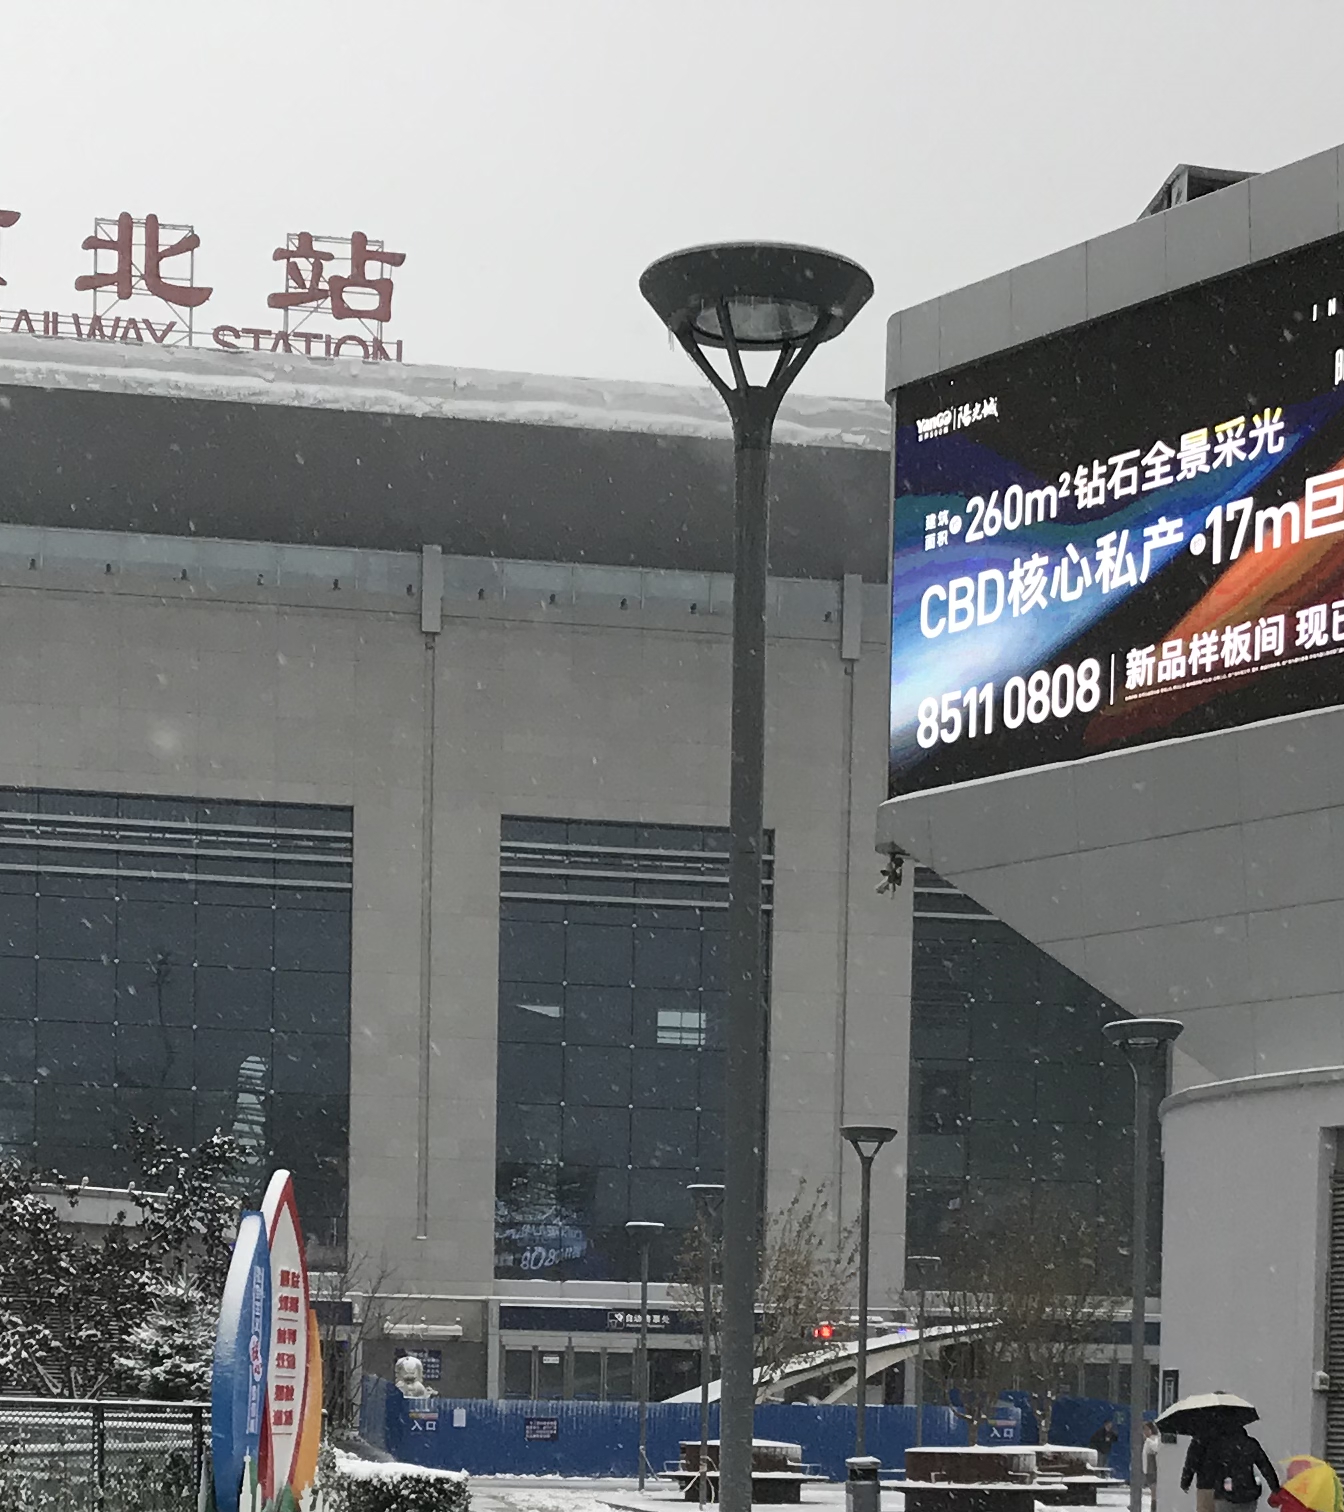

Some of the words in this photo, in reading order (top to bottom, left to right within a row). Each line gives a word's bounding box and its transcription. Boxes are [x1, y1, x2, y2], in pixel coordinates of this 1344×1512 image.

[212, 325, 403, 362] STATION
[1124, 614, 1286, 691] 新品样板间
[411, 1420, 437, 1431] 入口
[990, 1426, 1014, 1438] 入口
